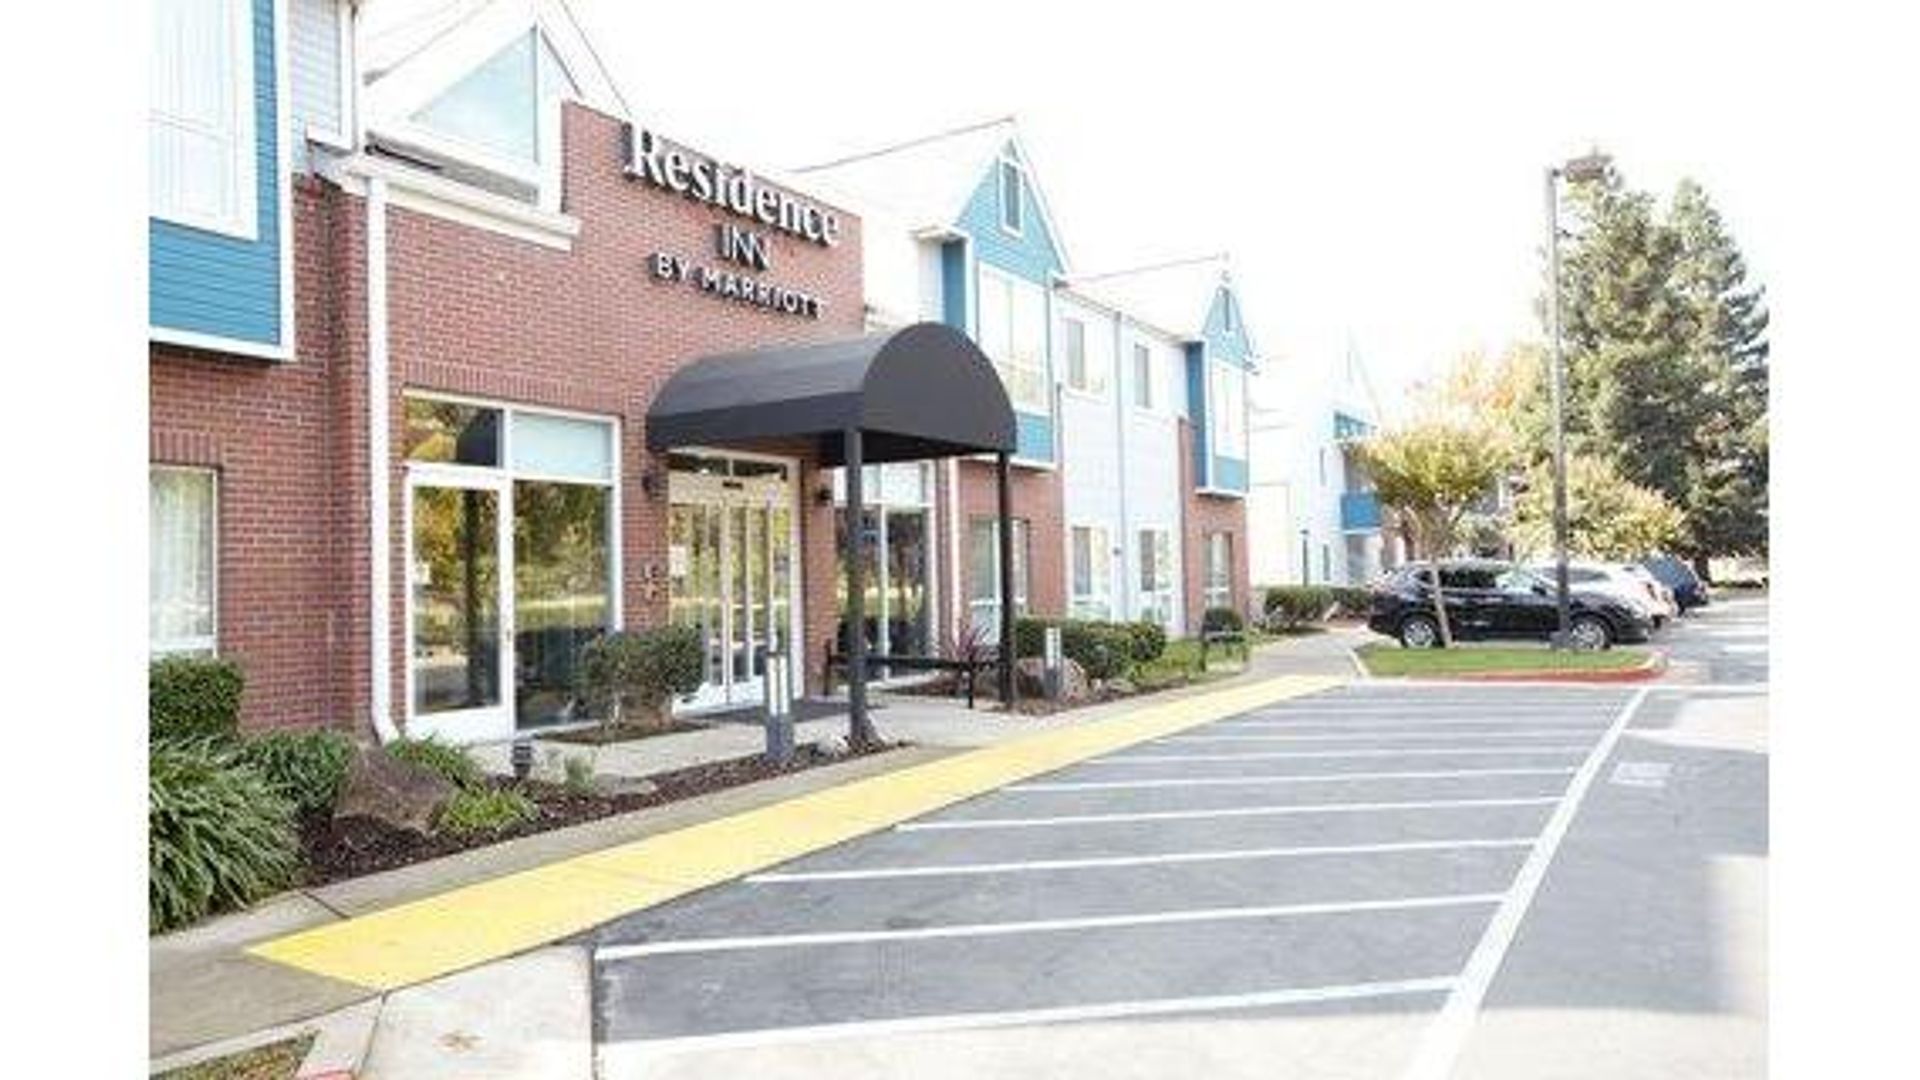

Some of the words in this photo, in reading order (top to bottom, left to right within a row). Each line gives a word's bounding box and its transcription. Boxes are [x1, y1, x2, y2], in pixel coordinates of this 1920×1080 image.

[623, 121, 840, 247] Residence
[718, 223, 771, 270] INN
[652, 252, 691, 281] BY
[700, 267, 828, 319] MARRIOTT
